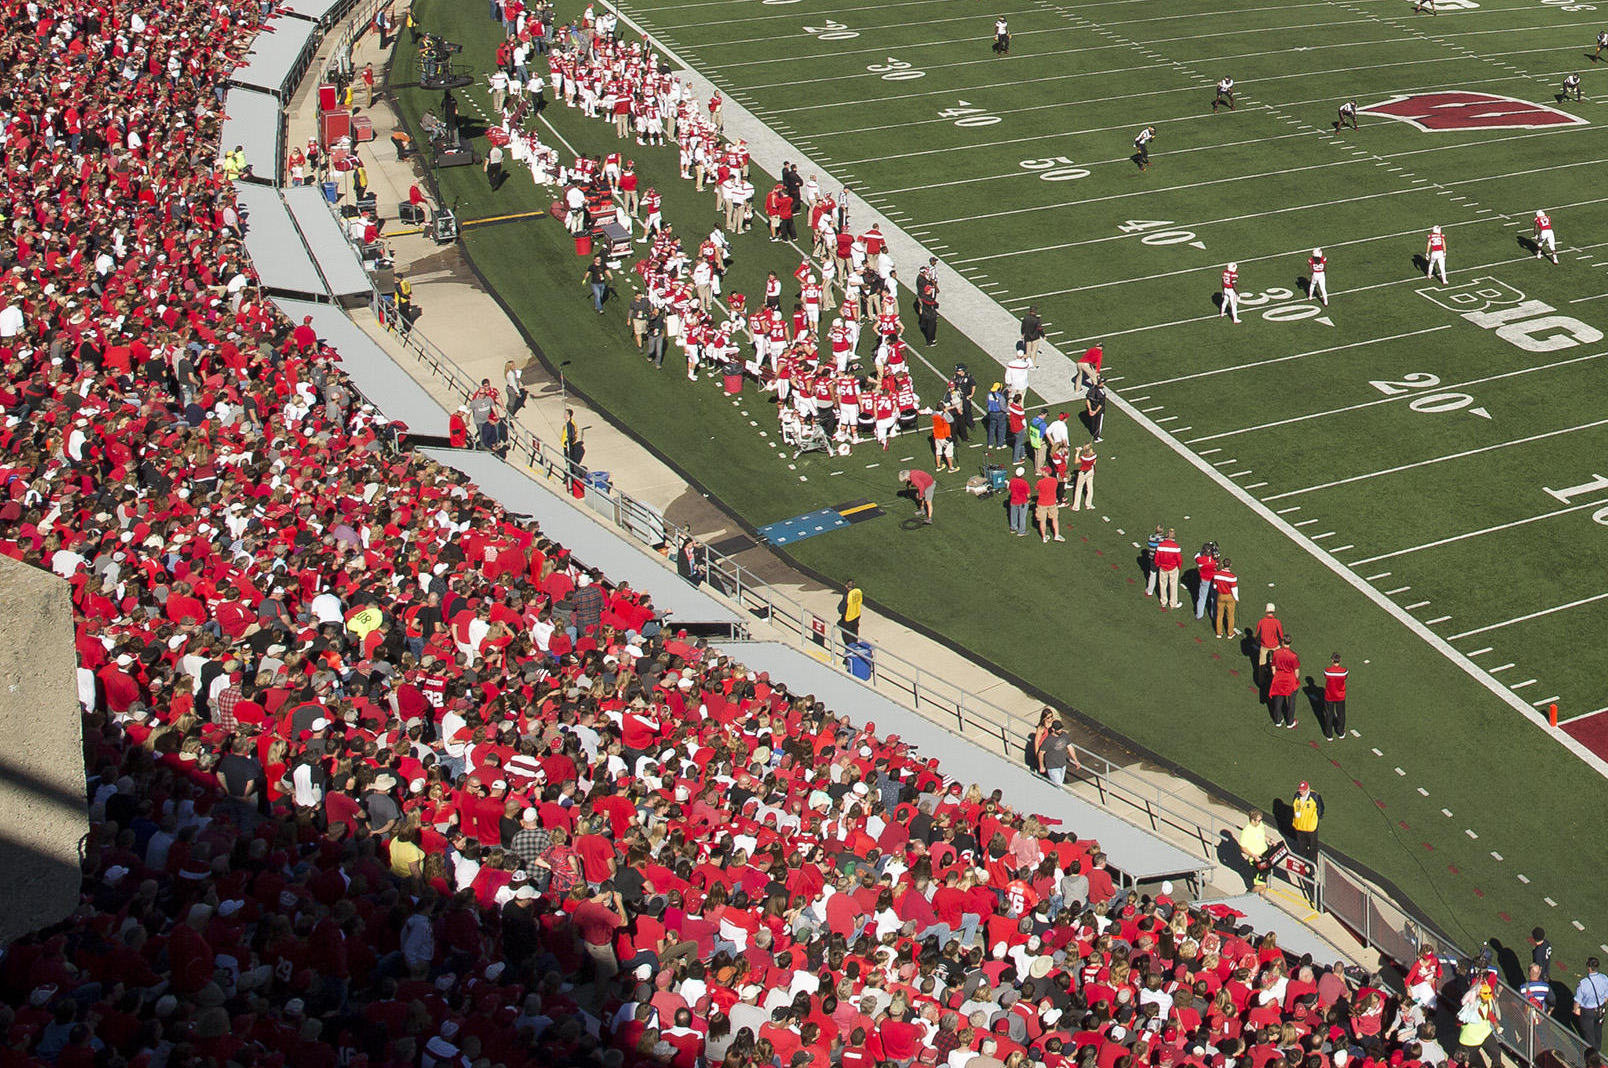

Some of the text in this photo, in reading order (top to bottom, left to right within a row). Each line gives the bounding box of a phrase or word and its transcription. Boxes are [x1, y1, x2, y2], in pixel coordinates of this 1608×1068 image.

[803, 22, 860, 40] 20
[866, 62, 926, 81] 30
[937, 107, 1002, 127] 40
[1019, 156, 1090, 181] 50
[1118, 219, 1196, 246] 40
[1237, 287, 1321, 322] 30
[770, 329, 784, 338] 44
[841, 385, 854, 396] 64
[1369, 372, 1473, 413] 20
[878, 399, 892, 410] 74
[899, 396, 913, 407] 55
